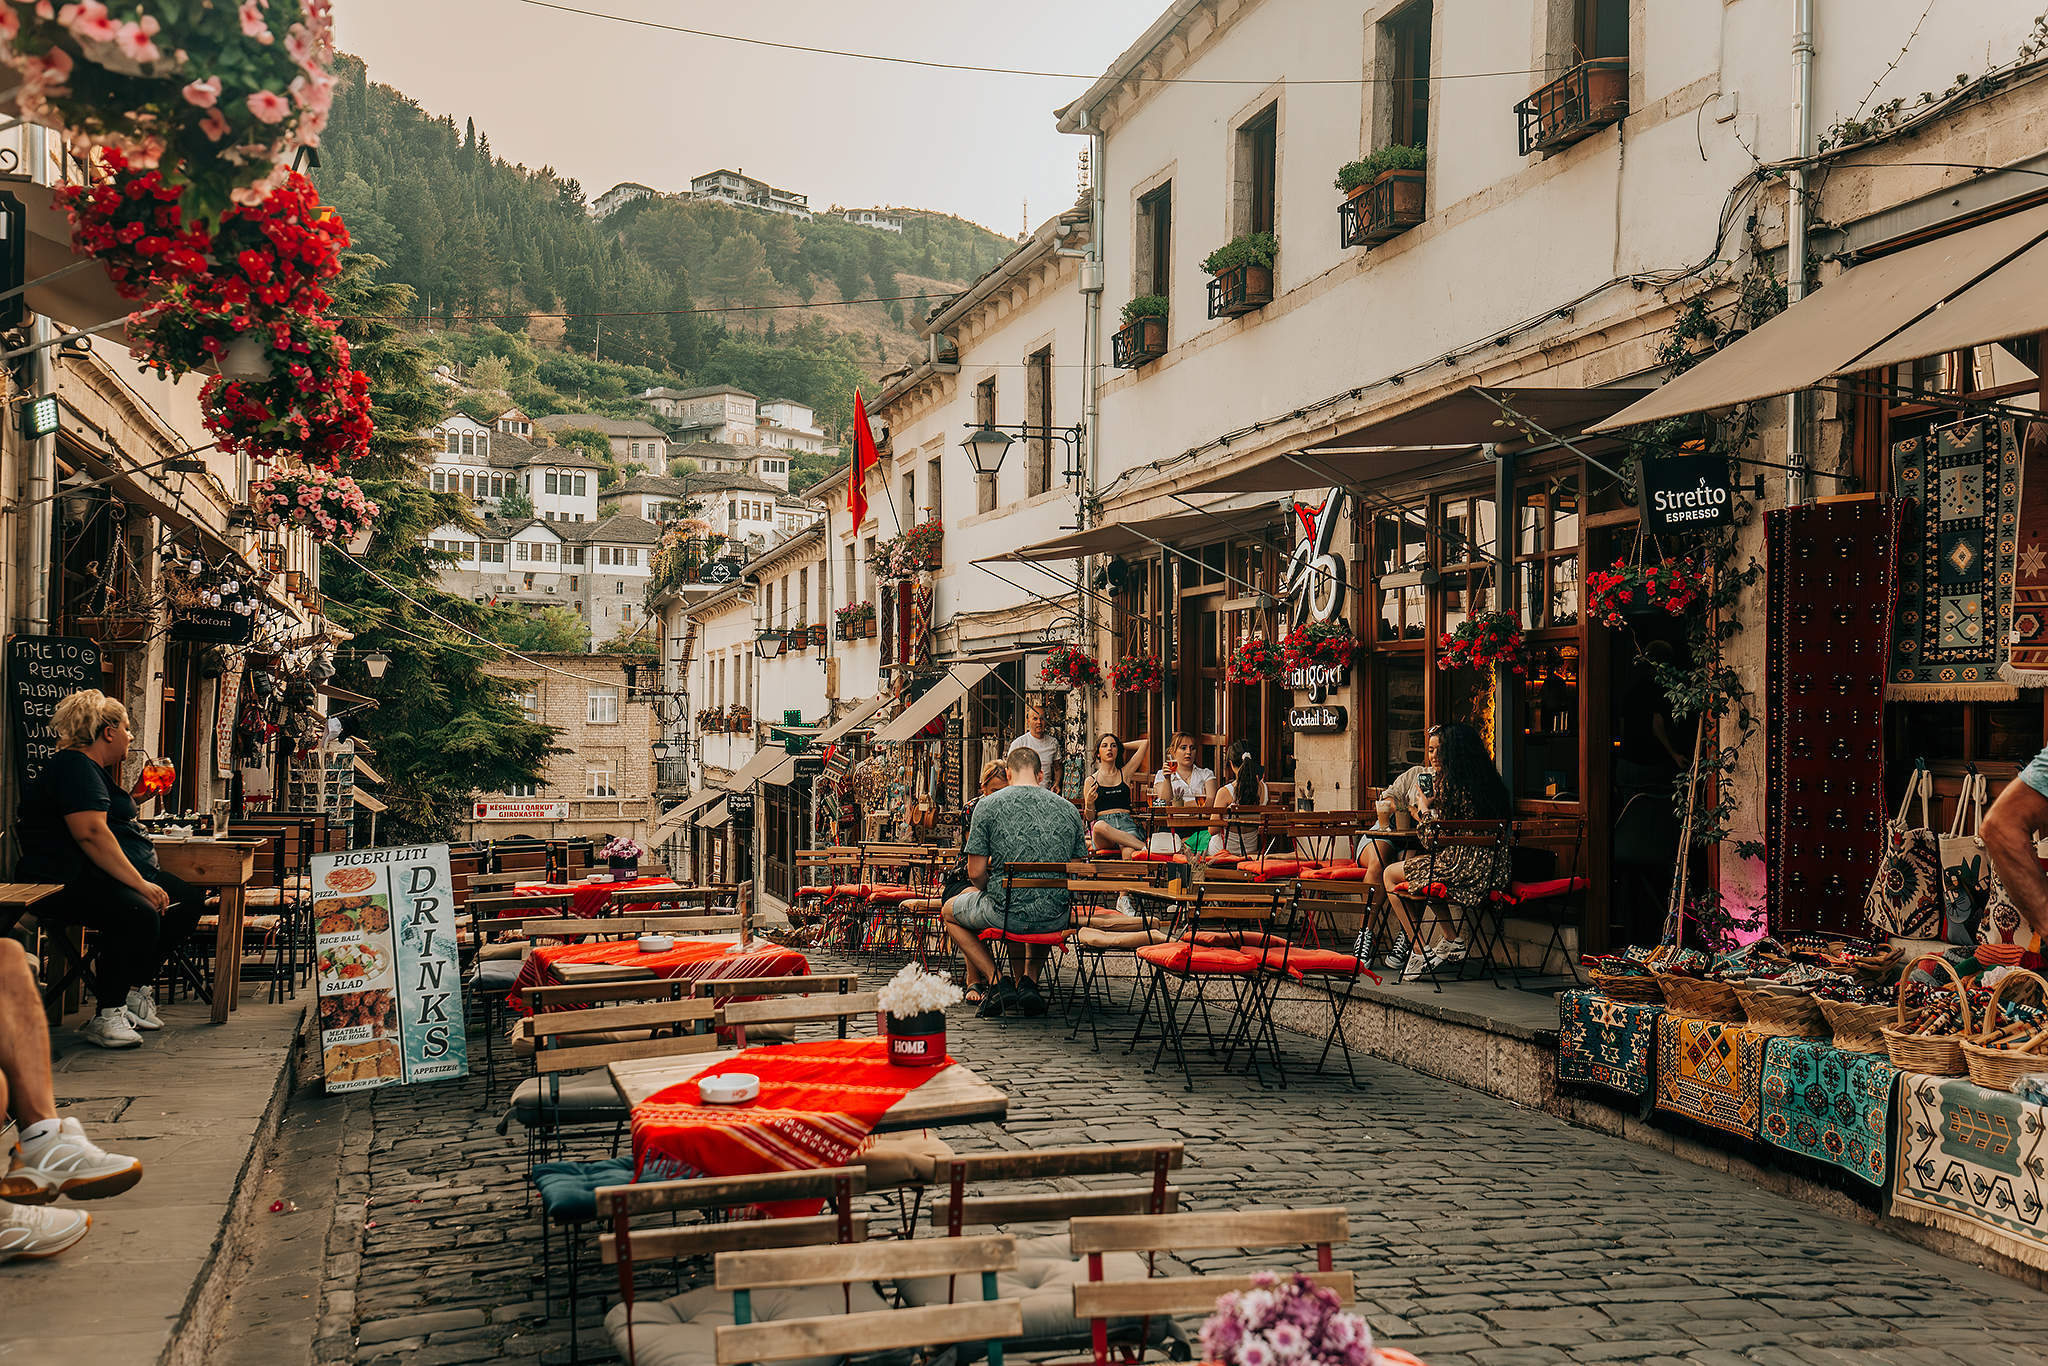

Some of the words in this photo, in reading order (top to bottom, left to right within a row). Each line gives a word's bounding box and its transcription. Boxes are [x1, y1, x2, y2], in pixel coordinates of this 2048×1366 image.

[1654, 486, 1727, 511] Stretto
[1665, 507, 1720, 523] ESPRESSO
[192, 614, 231, 627] Kotoni
[15, 641, 53, 660] TIME
[57, 643, 78, 659] TO
[23, 700, 60, 717] BEE
[1290, 709, 1320, 727] Cocktail
[1322, 708, 1337, 726] Bar
[333, 850, 391, 867] PICERI
[394, 848, 428, 862] LITI
[314, 890, 338, 898] PIZZA
[319, 936, 339, 945] RICE
[340, 934, 361, 943] BALL
[407, 866, 451, 1057] DRINKS
[326, 979, 363, 992] SALAD
[326, 1035, 347, 1043] MADE
[348, 1032, 370, 1040] HOME
[329, 1027, 367, 1037] MEATBALL
[894, 1040, 925, 1054] HOME
[413, 1064, 459, 1075] APPETIZER
[328, 1083, 346, 1091] CORN
